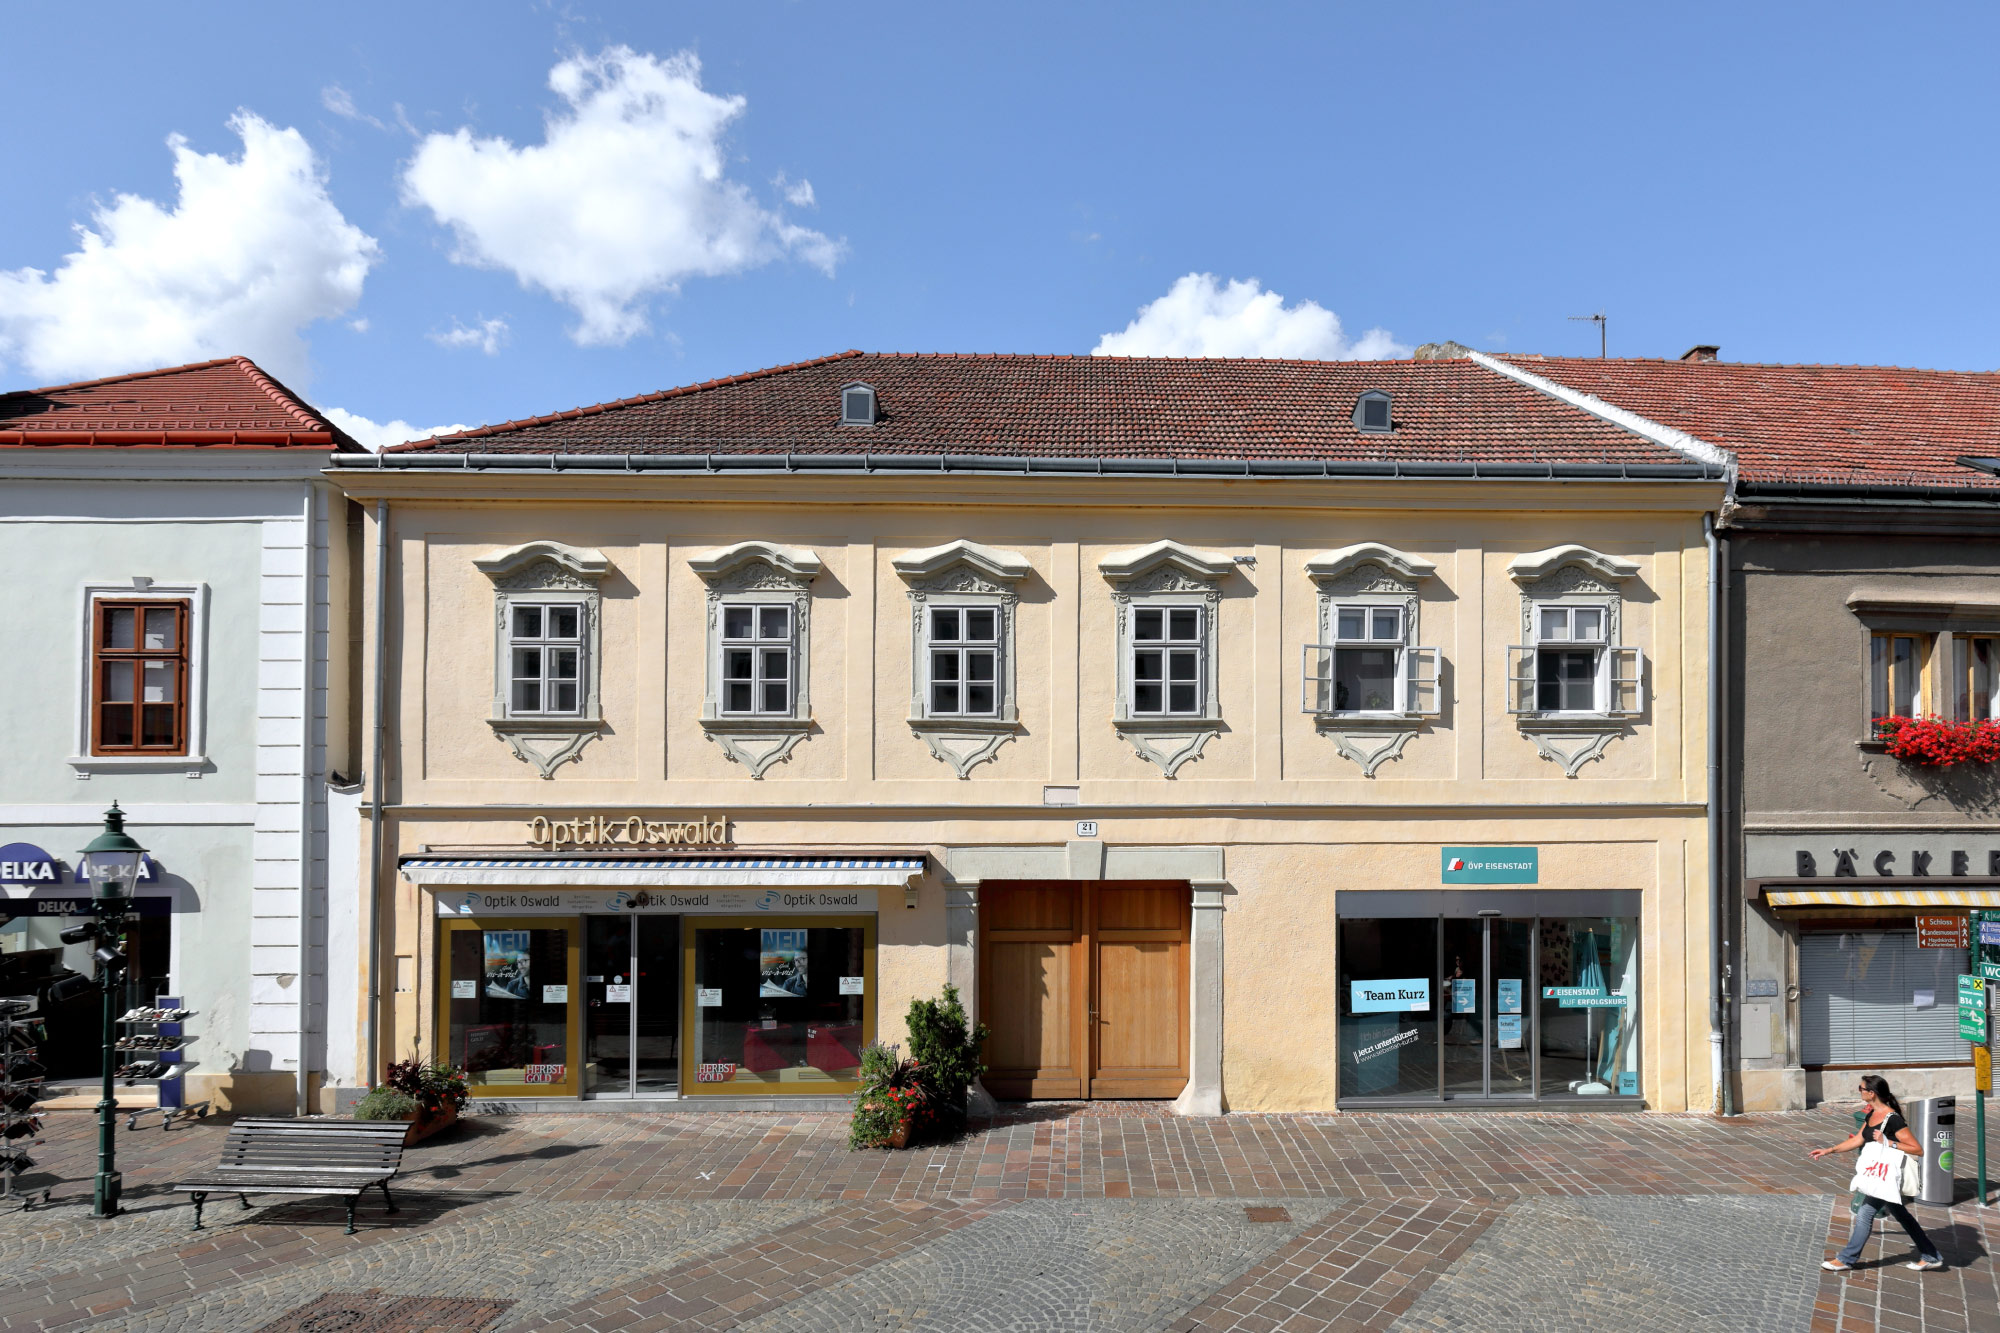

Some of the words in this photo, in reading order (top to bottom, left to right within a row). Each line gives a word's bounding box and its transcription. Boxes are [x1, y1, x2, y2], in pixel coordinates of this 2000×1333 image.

[1082, 823, 1092, 831] 21
[531, 815, 616, 851] Optik
[625, 815, 727, 845] Oswald
[1468, 860, 1484, 870] ÖVP
[1485, 862, 1533, 870] EISENSTADT
[0, 861, 55, 880] ELKA
[484, 895, 517, 910] Optik
[520, 895, 560, 907] Oswald
[670, 895, 709, 906] Oswald
[783, 893, 816, 908] Optik
[819, 893, 858, 905] Oswald
[38, 901, 77, 913] DELKA
[1929, 918, 1953, 926] Schloss
[762, 930, 806, 952] NEU
[1985, 965, 2000, 977] WC
[1364, 990, 1396, 1001] Team
[1398, 989, 1425, 1000] Kurz
[1556, 988, 1600, 996] EISENSTADT
[1561, 998, 1577, 1006] AUF
[1577, 998, 1627, 1006] ERFOLGSKURS
[1960, 997, 1973, 1005] B14
[1358, 1045, 1375, 1057] Jetzt
[1374, 1028, 1419, 1050] unterstützen:
[526, 1064, 564, 1074] HERBST
[699, 1063, 735, 1073] HERBST
[526, 1073, 552, 1083] GOLD
[698, 1072, 724, 1082] GOLD
